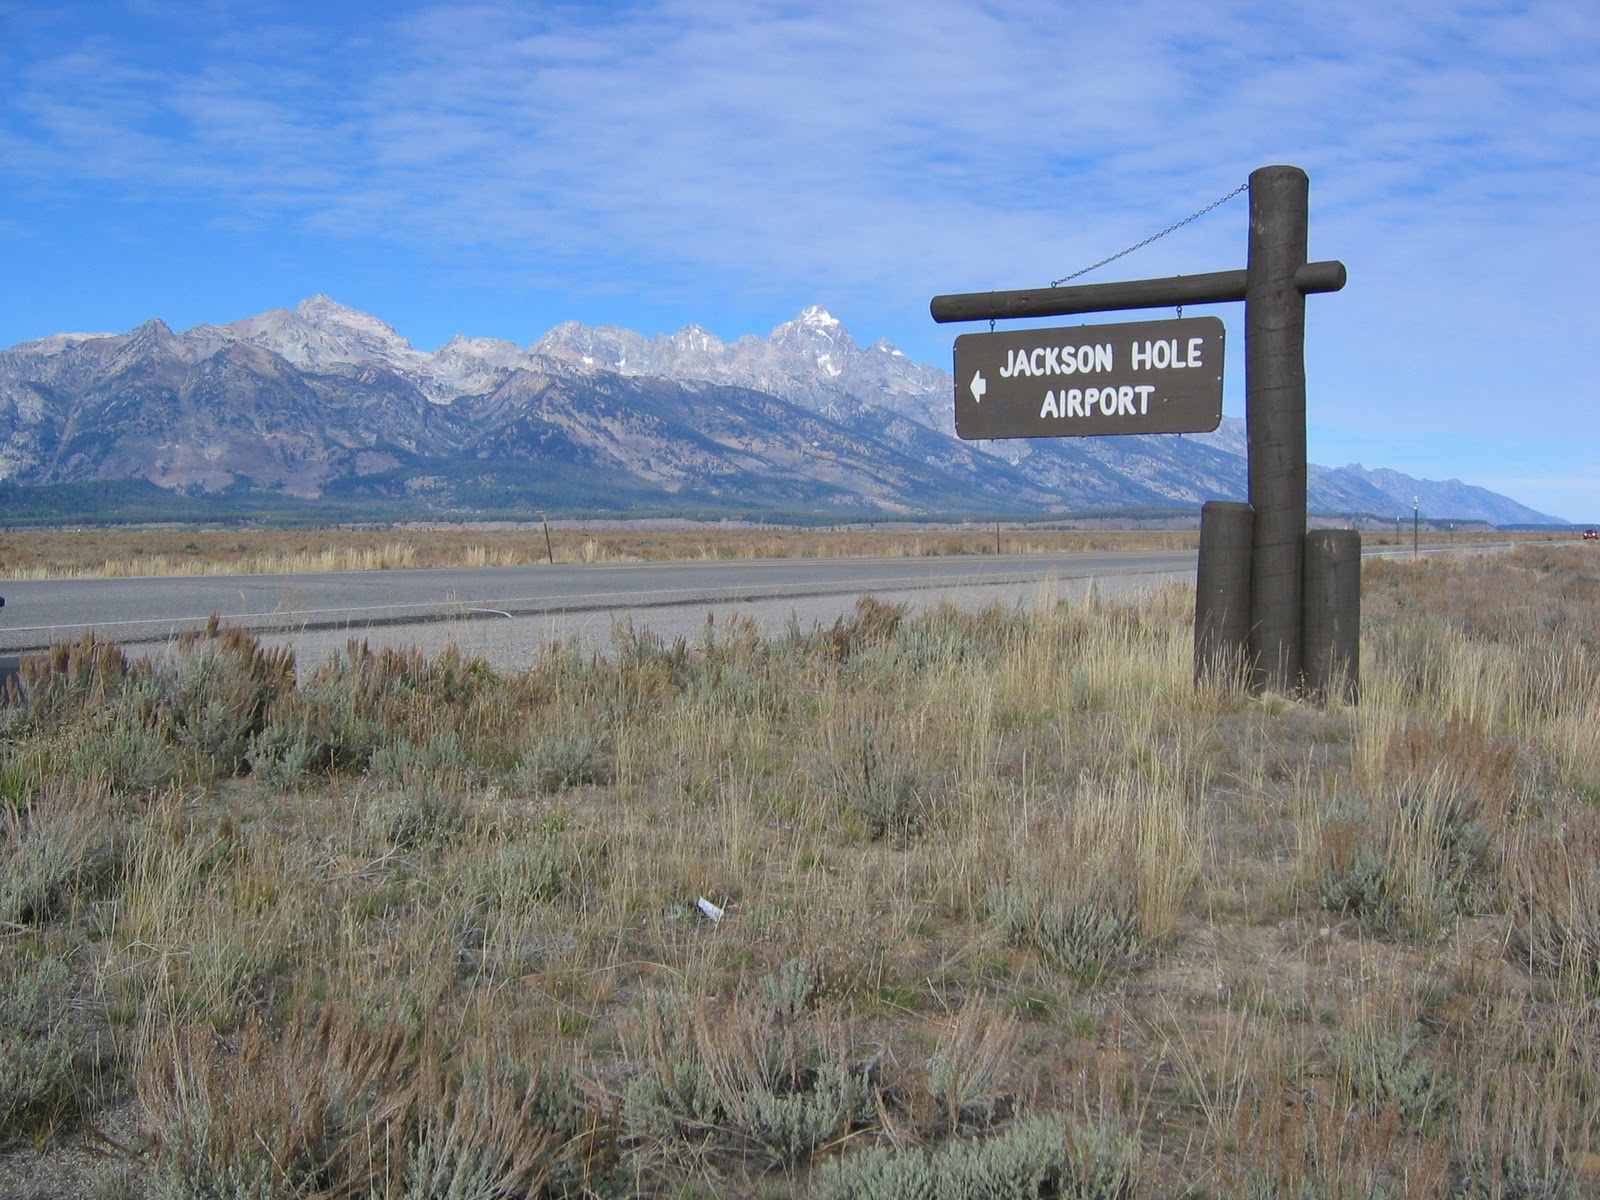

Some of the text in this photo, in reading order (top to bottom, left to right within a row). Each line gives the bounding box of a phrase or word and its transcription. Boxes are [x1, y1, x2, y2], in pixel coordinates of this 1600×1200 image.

[999, 337, 1204, 378] JACKSON HOLE
[1039, 385, 1156, 419] AIRPORT
